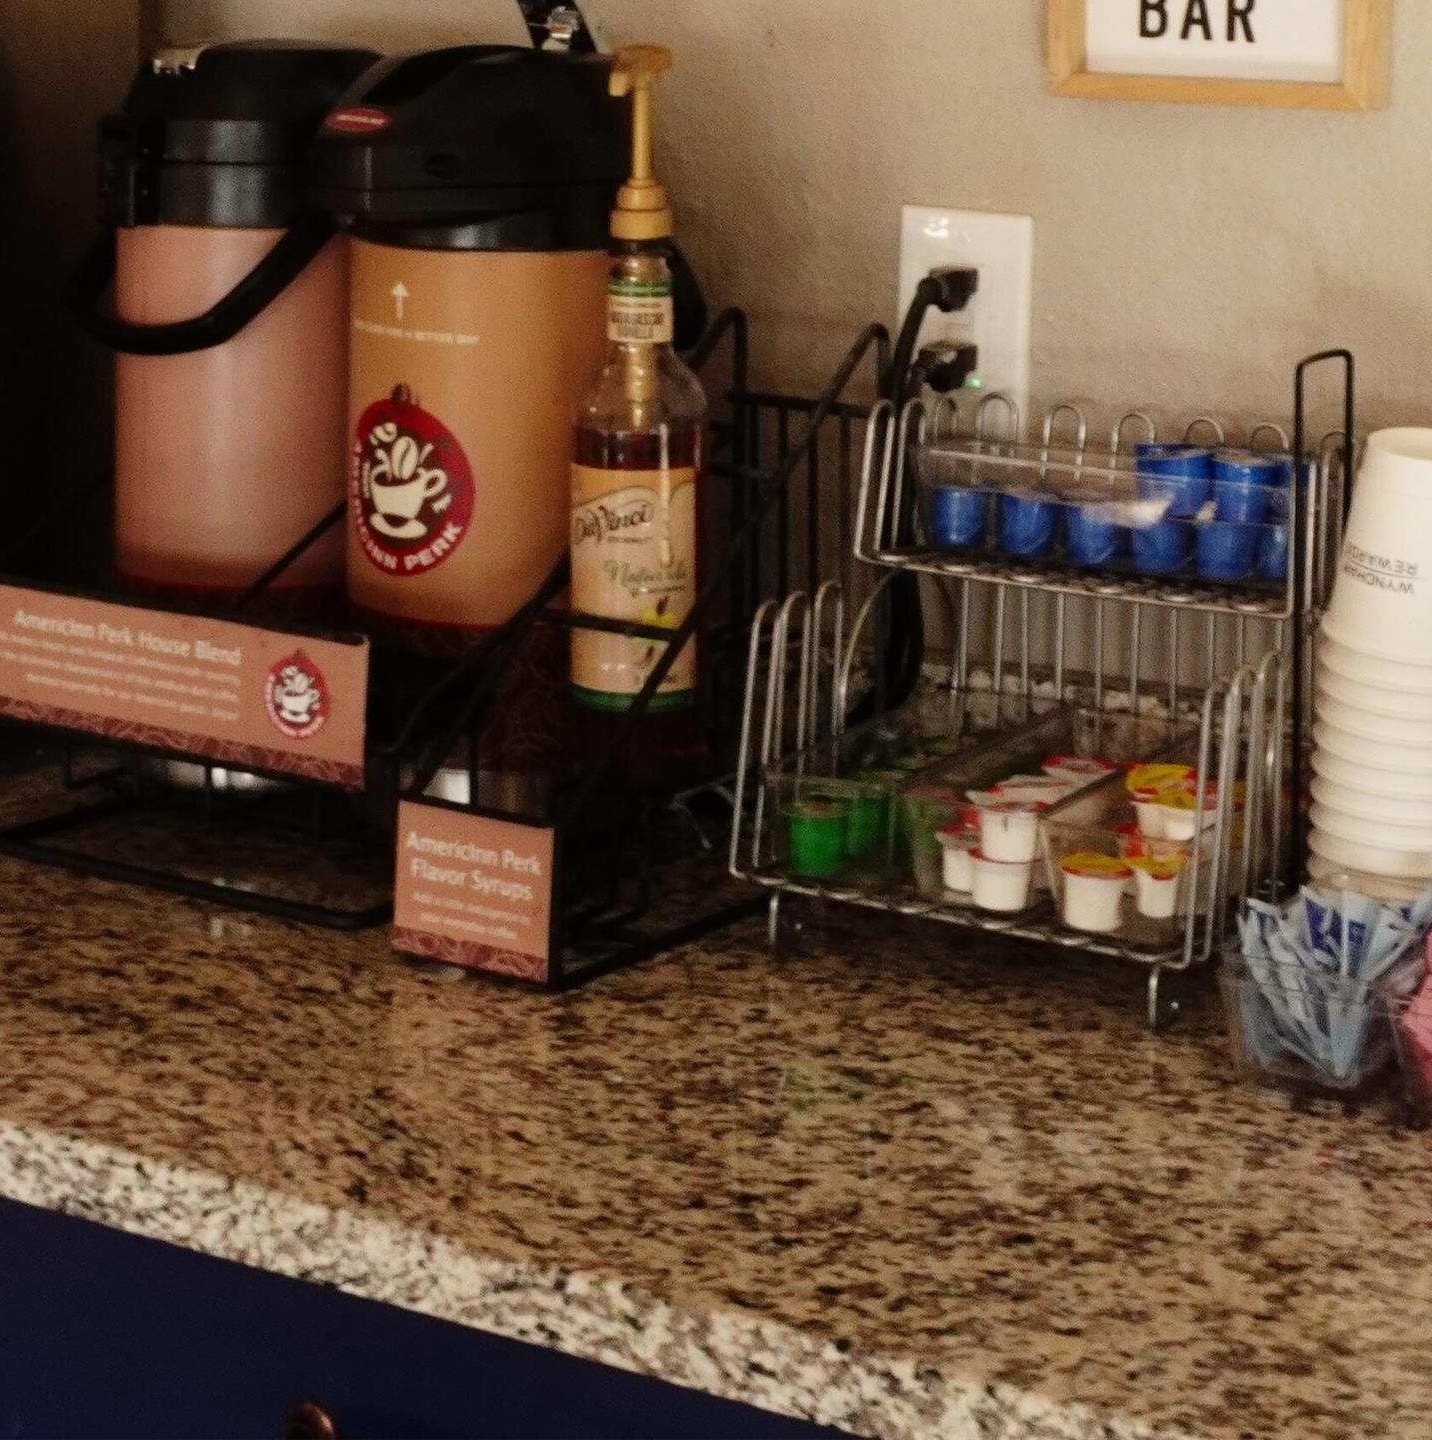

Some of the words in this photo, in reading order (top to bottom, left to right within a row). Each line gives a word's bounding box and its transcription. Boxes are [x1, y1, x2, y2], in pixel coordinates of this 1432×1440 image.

[403, 521, 463, 570] PERK
[194, 639, 241, 666] Blend
[410, 857, 466, 887] Flavor
[470, 869, 534, 902] Syrups
[502, 849, 541, 876] Perk
